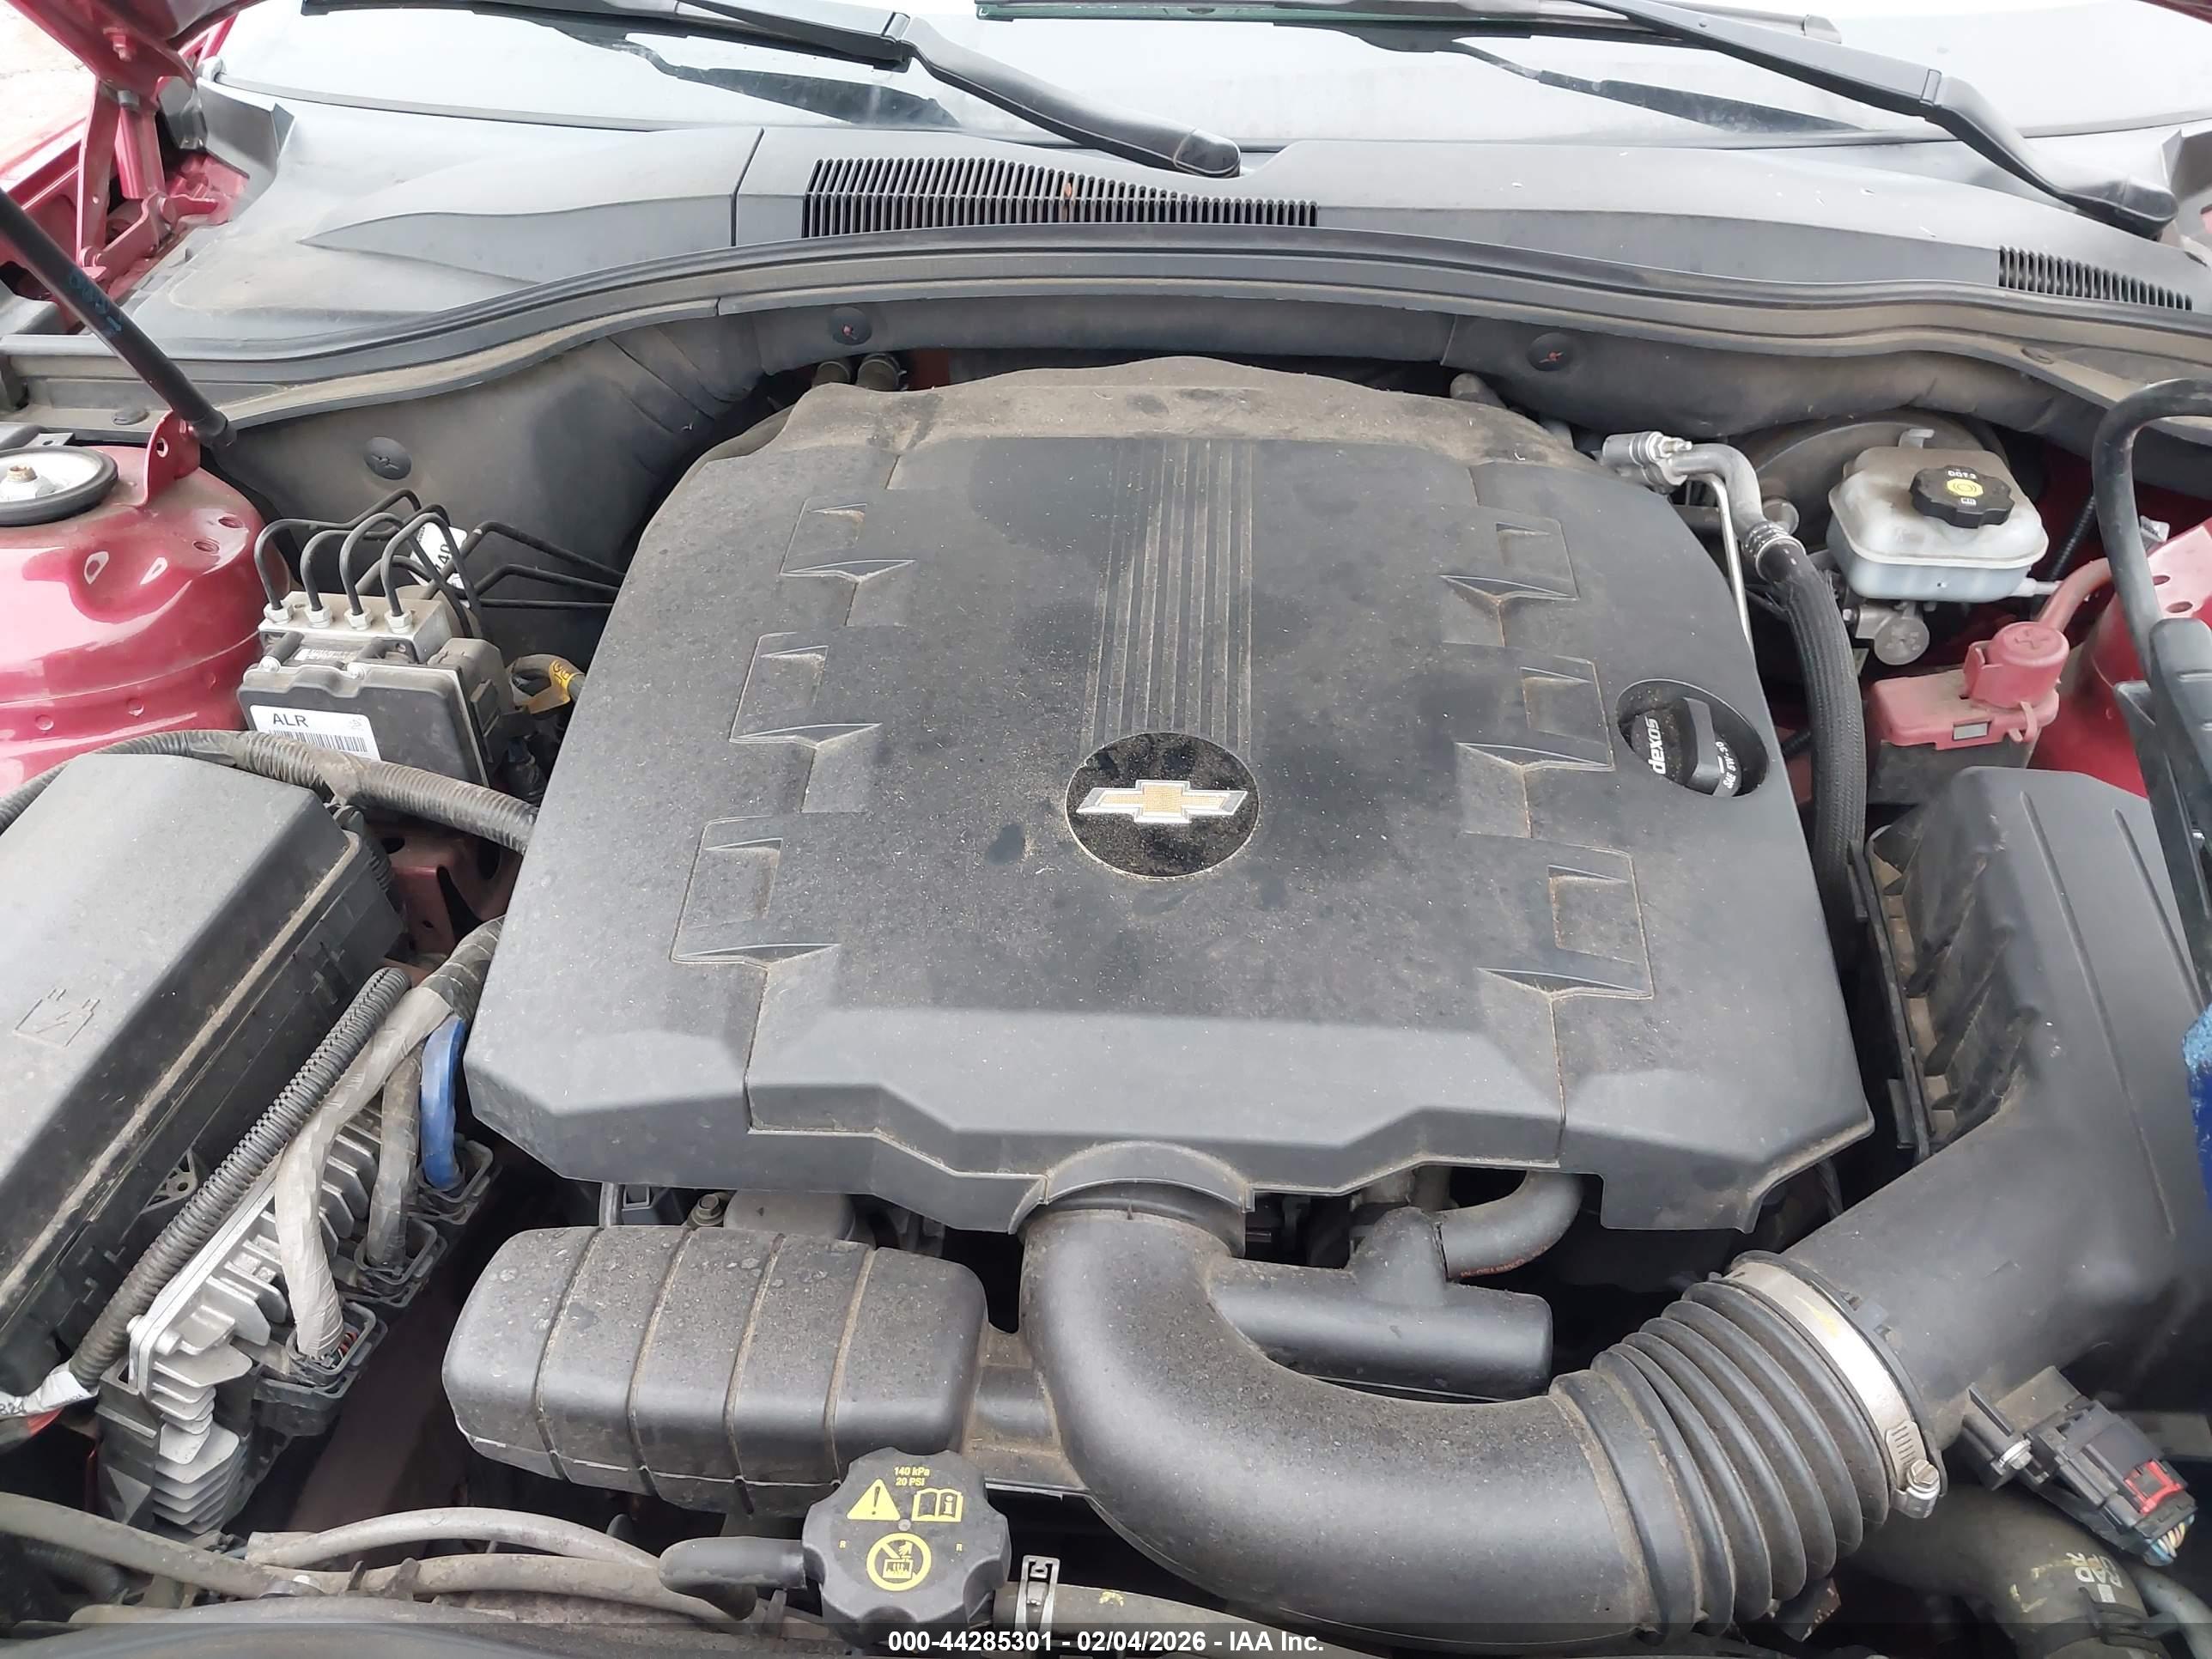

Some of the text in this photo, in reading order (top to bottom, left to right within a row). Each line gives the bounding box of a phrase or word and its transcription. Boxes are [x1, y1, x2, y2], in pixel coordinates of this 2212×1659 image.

[273, 714, 309, 728] ALR
[1644, 716, 1667, 775] dexos
[1715, 741, 1736, 789] SAE 5W-30
[894, 1467, 930, 1476] 140 kPa
[896, 1478, 926, 1486] 20 PSI
[2075, 1567, 2124, 1589] RAD
